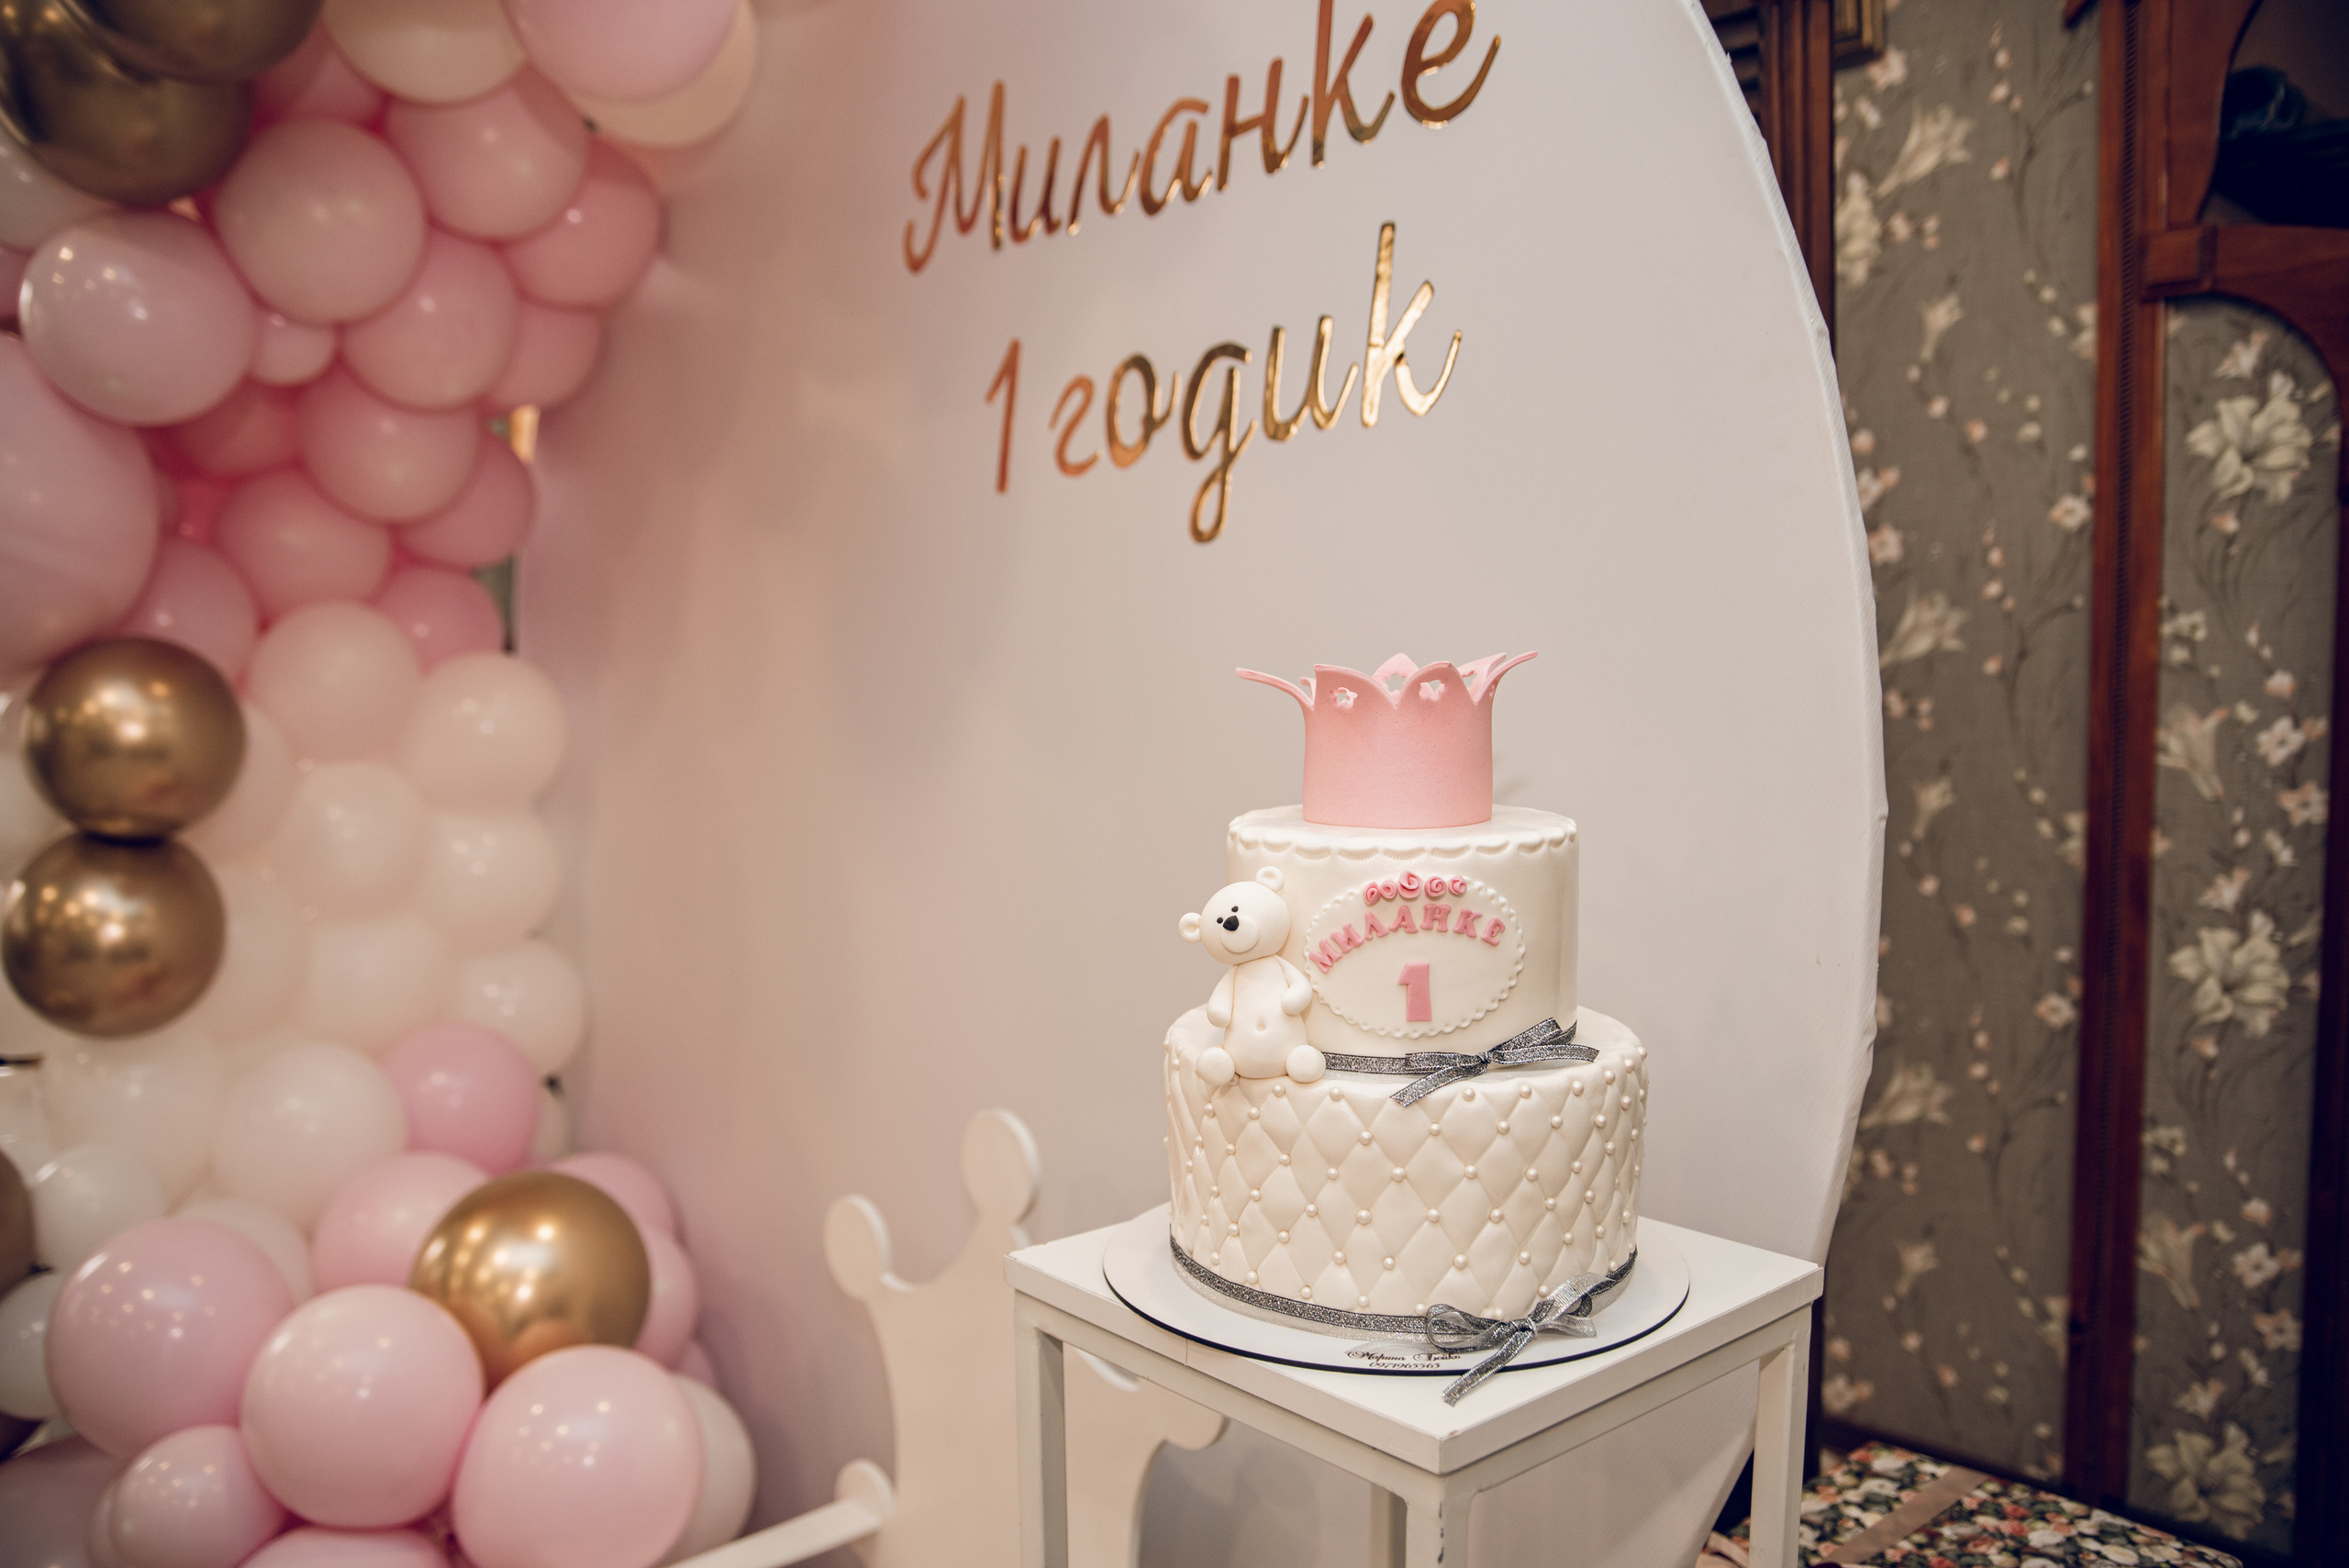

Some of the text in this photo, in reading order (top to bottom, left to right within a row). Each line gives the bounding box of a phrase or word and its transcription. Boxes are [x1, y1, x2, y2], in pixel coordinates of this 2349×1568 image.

[903, 0, 1501, 273] Миланке
[985, 221, 1463, 544] 1 годик
[1308, 904, 1506, 974] МИЛАНКЕ
[1398, 962, 1432, 1022] 1
